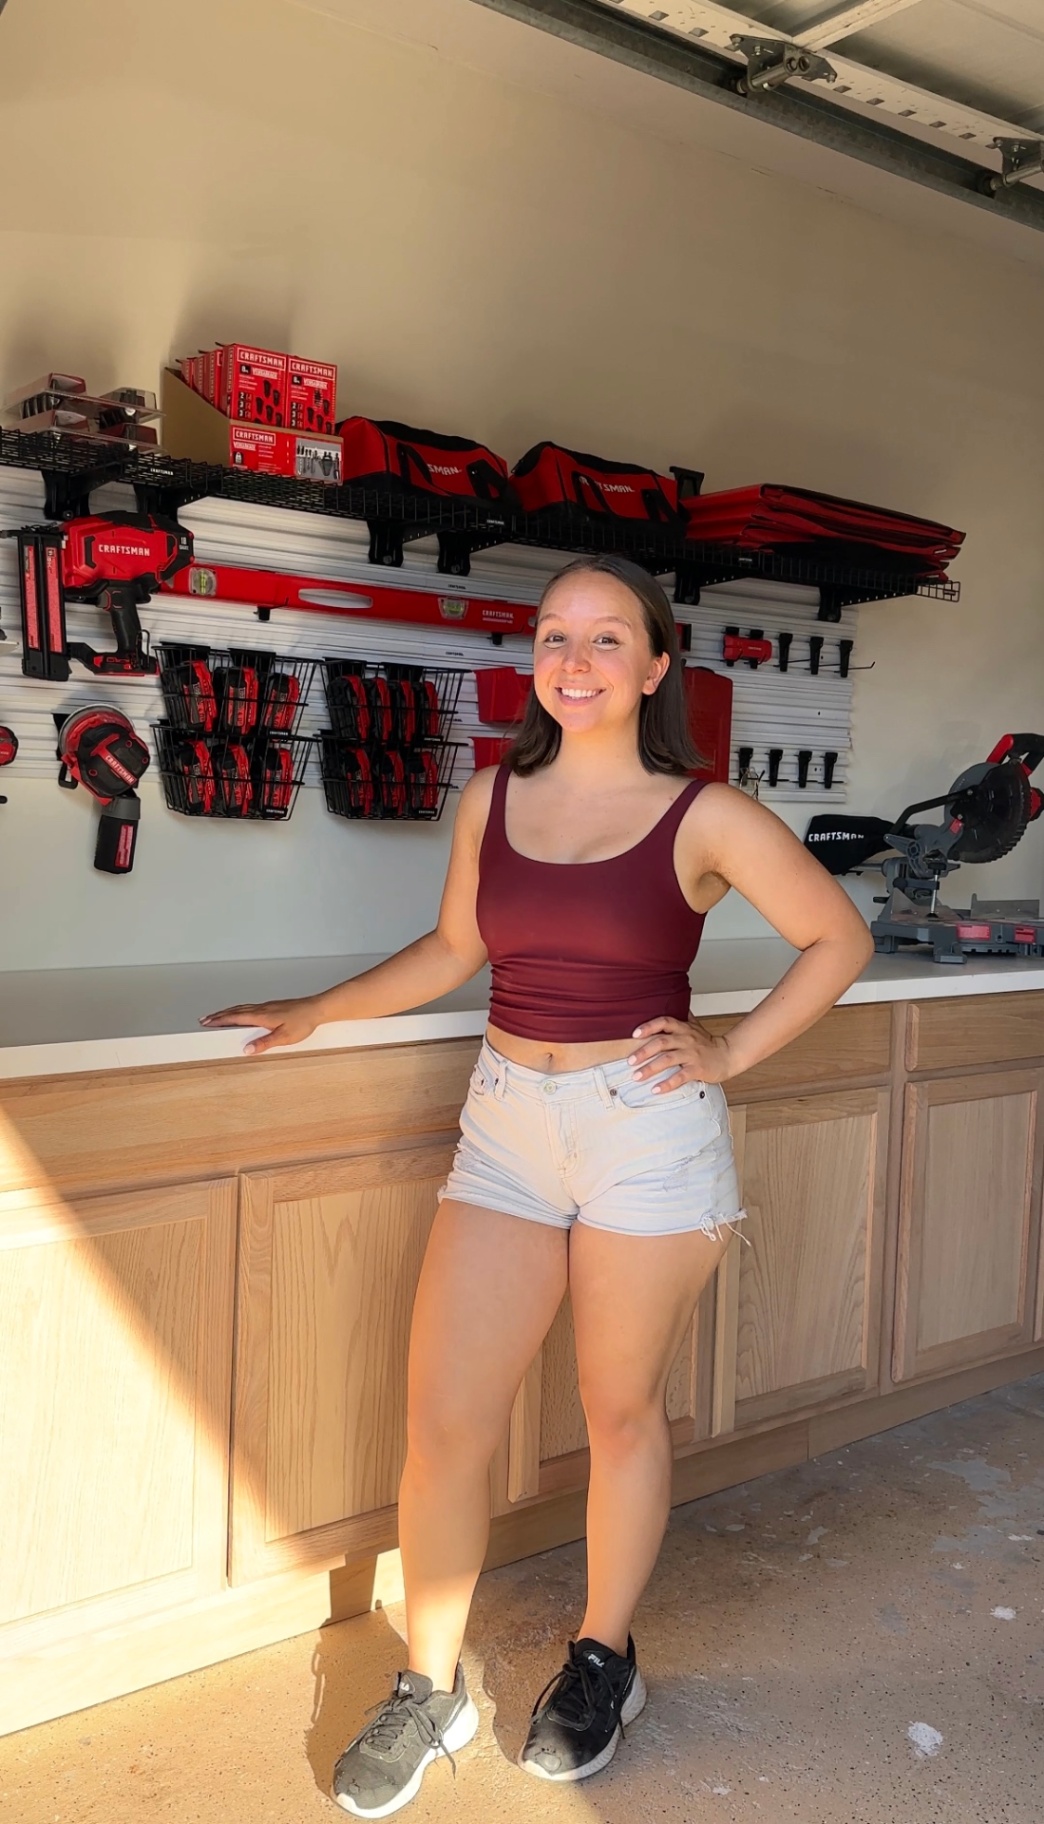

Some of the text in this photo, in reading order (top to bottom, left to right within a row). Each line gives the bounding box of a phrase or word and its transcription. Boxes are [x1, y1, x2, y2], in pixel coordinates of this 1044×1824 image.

[239, 350, 284, 368] CRAFTSMAN
[291, 361, 333, 378] CRAFTSMAN
[235, 429, 274, 444] CRAFTSMAN
[98, 544, 150, 557] CRAFTSMAN
[105, 755, 135, 784] CRAFTSMAN
[808, 831, 865, 842] CRAFTSMAN
